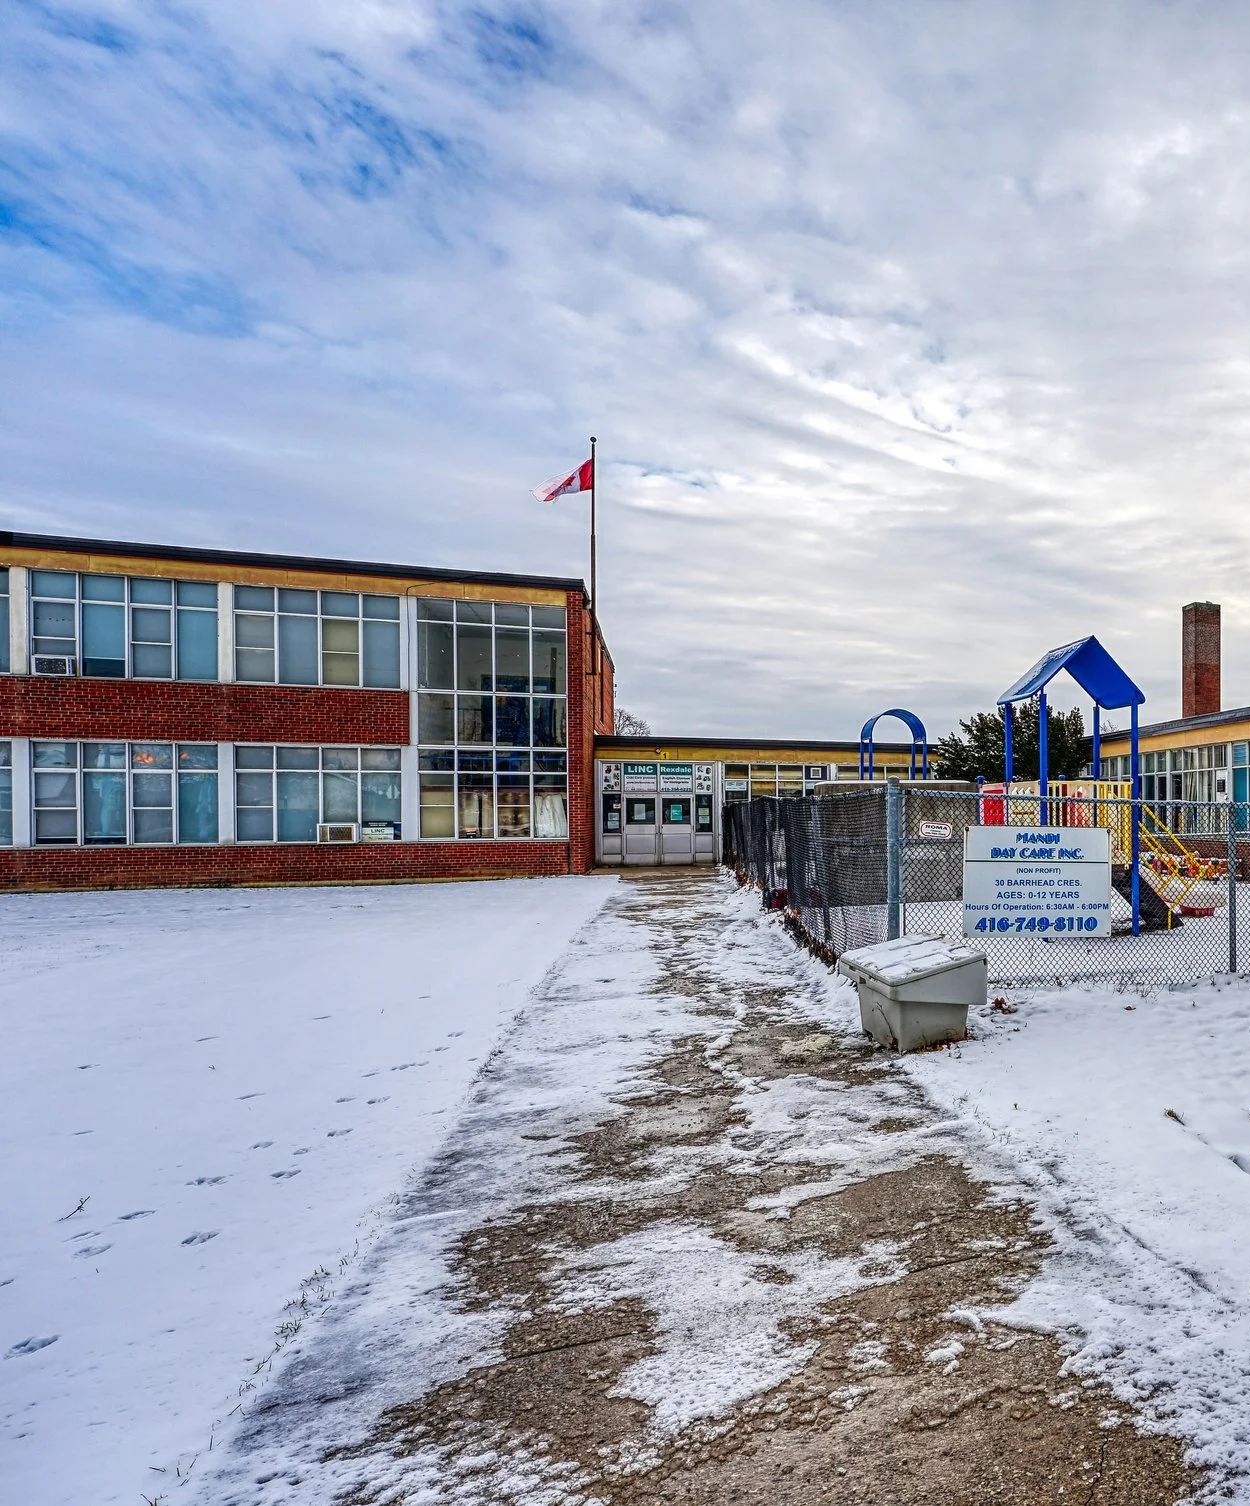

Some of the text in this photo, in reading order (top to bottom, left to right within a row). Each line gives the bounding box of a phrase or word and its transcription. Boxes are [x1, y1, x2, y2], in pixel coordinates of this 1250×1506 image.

[1016, 832, 1060, 844] MANDI
[991, 847, 1084, 860] DAY CARE INC.
[996, 891, 1080, 899] AGES: 0-12 YEARS
[965, 903, 989, 911] Hours
[991, 903, 1001, 911] Of
[1003, 903, 1044, 912] Operation:
[1046, 903, 1075, 911] 6:30AM
[1081, 903, 1109, 911] 6:00PM
[974, 917, 1098, 932] 416-749-8110
